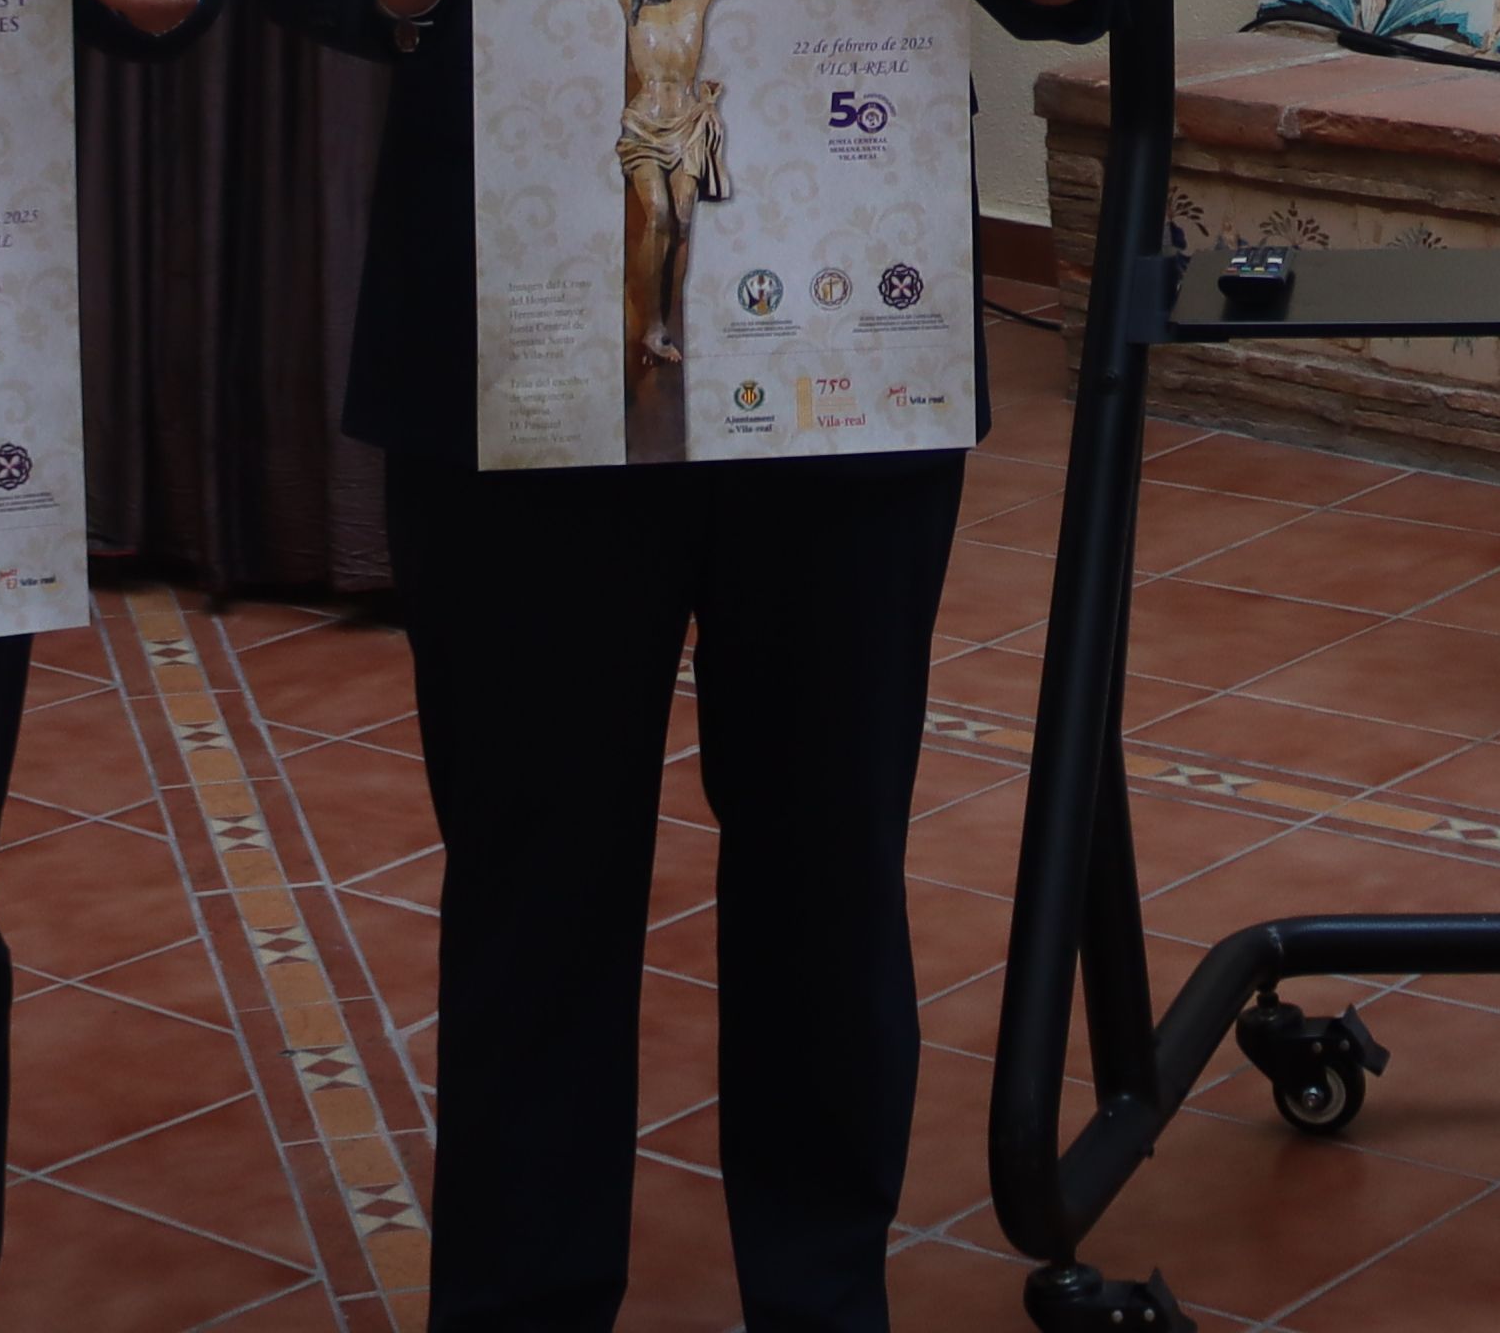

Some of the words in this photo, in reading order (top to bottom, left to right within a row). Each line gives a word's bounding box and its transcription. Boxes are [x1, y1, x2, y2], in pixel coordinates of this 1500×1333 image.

[794, 42, 810, 54] 22
[814, 39, 828, 53] de
[829, 37, 878, 57] febrero
[882, 37, 897, 51] de
[901, 37, 933, 50] 2025
[818, 60, 909, 78] VILA-REAL
[815, 413, 865, 427] Vila-real
